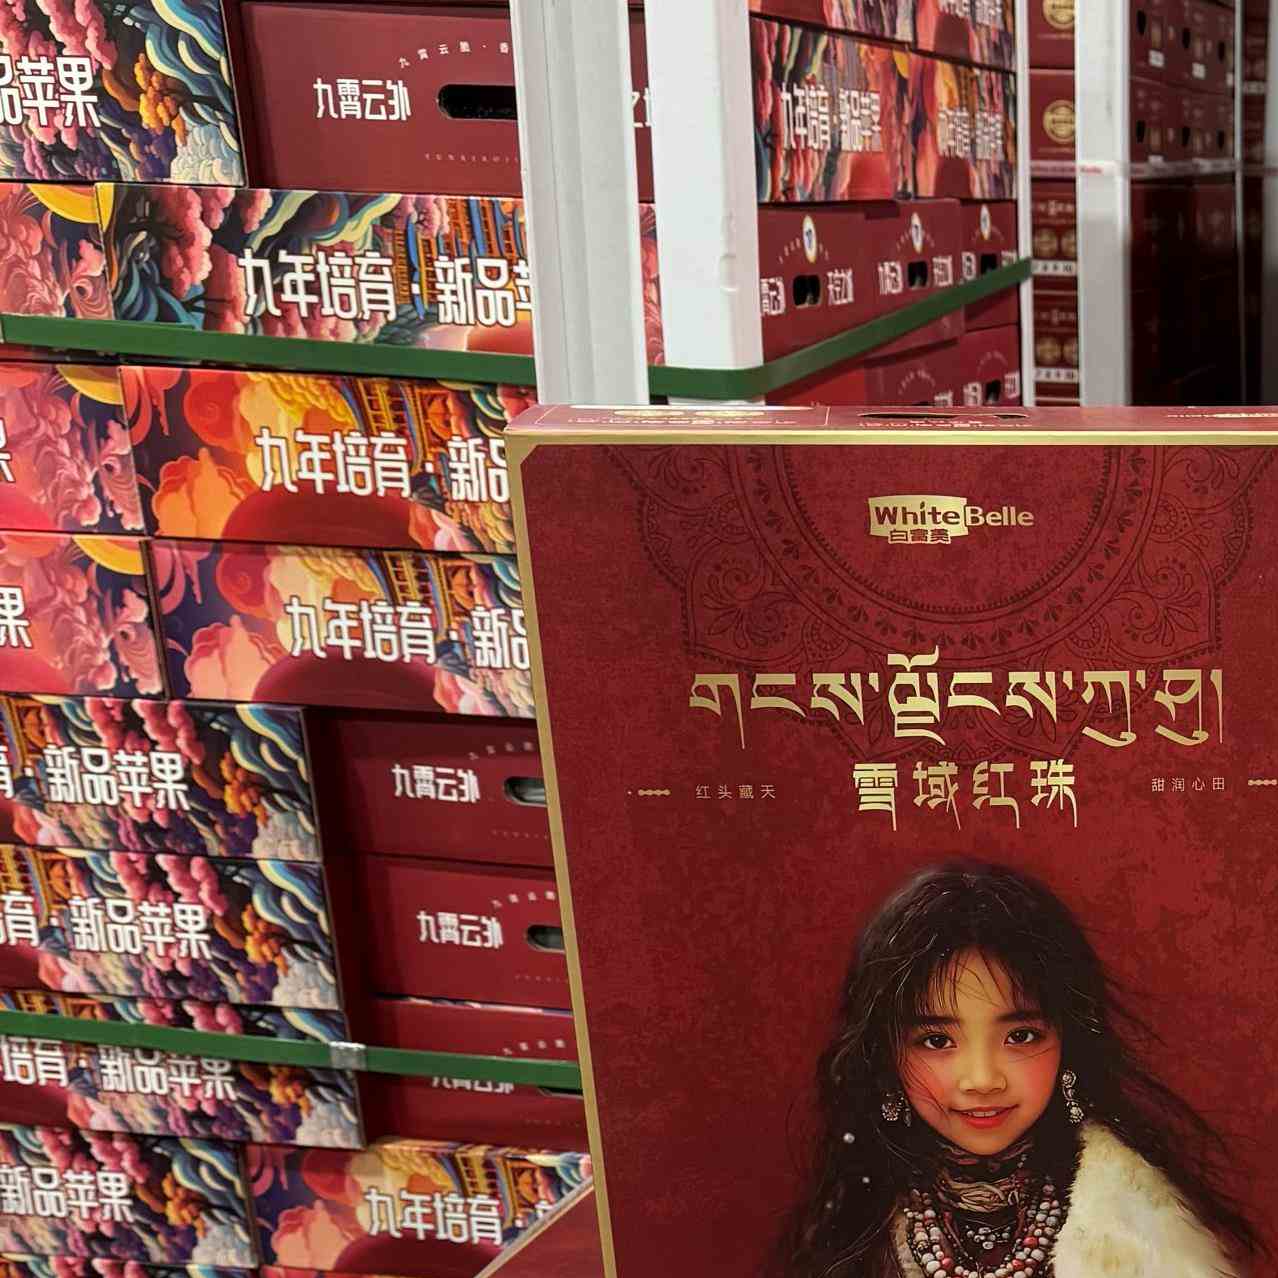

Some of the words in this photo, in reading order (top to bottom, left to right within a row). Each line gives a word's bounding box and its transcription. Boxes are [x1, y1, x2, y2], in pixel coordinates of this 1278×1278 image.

[853, 759, 1078, 831] 雪域红珠
[1151, 776, 1225, 792] 甜润心田
